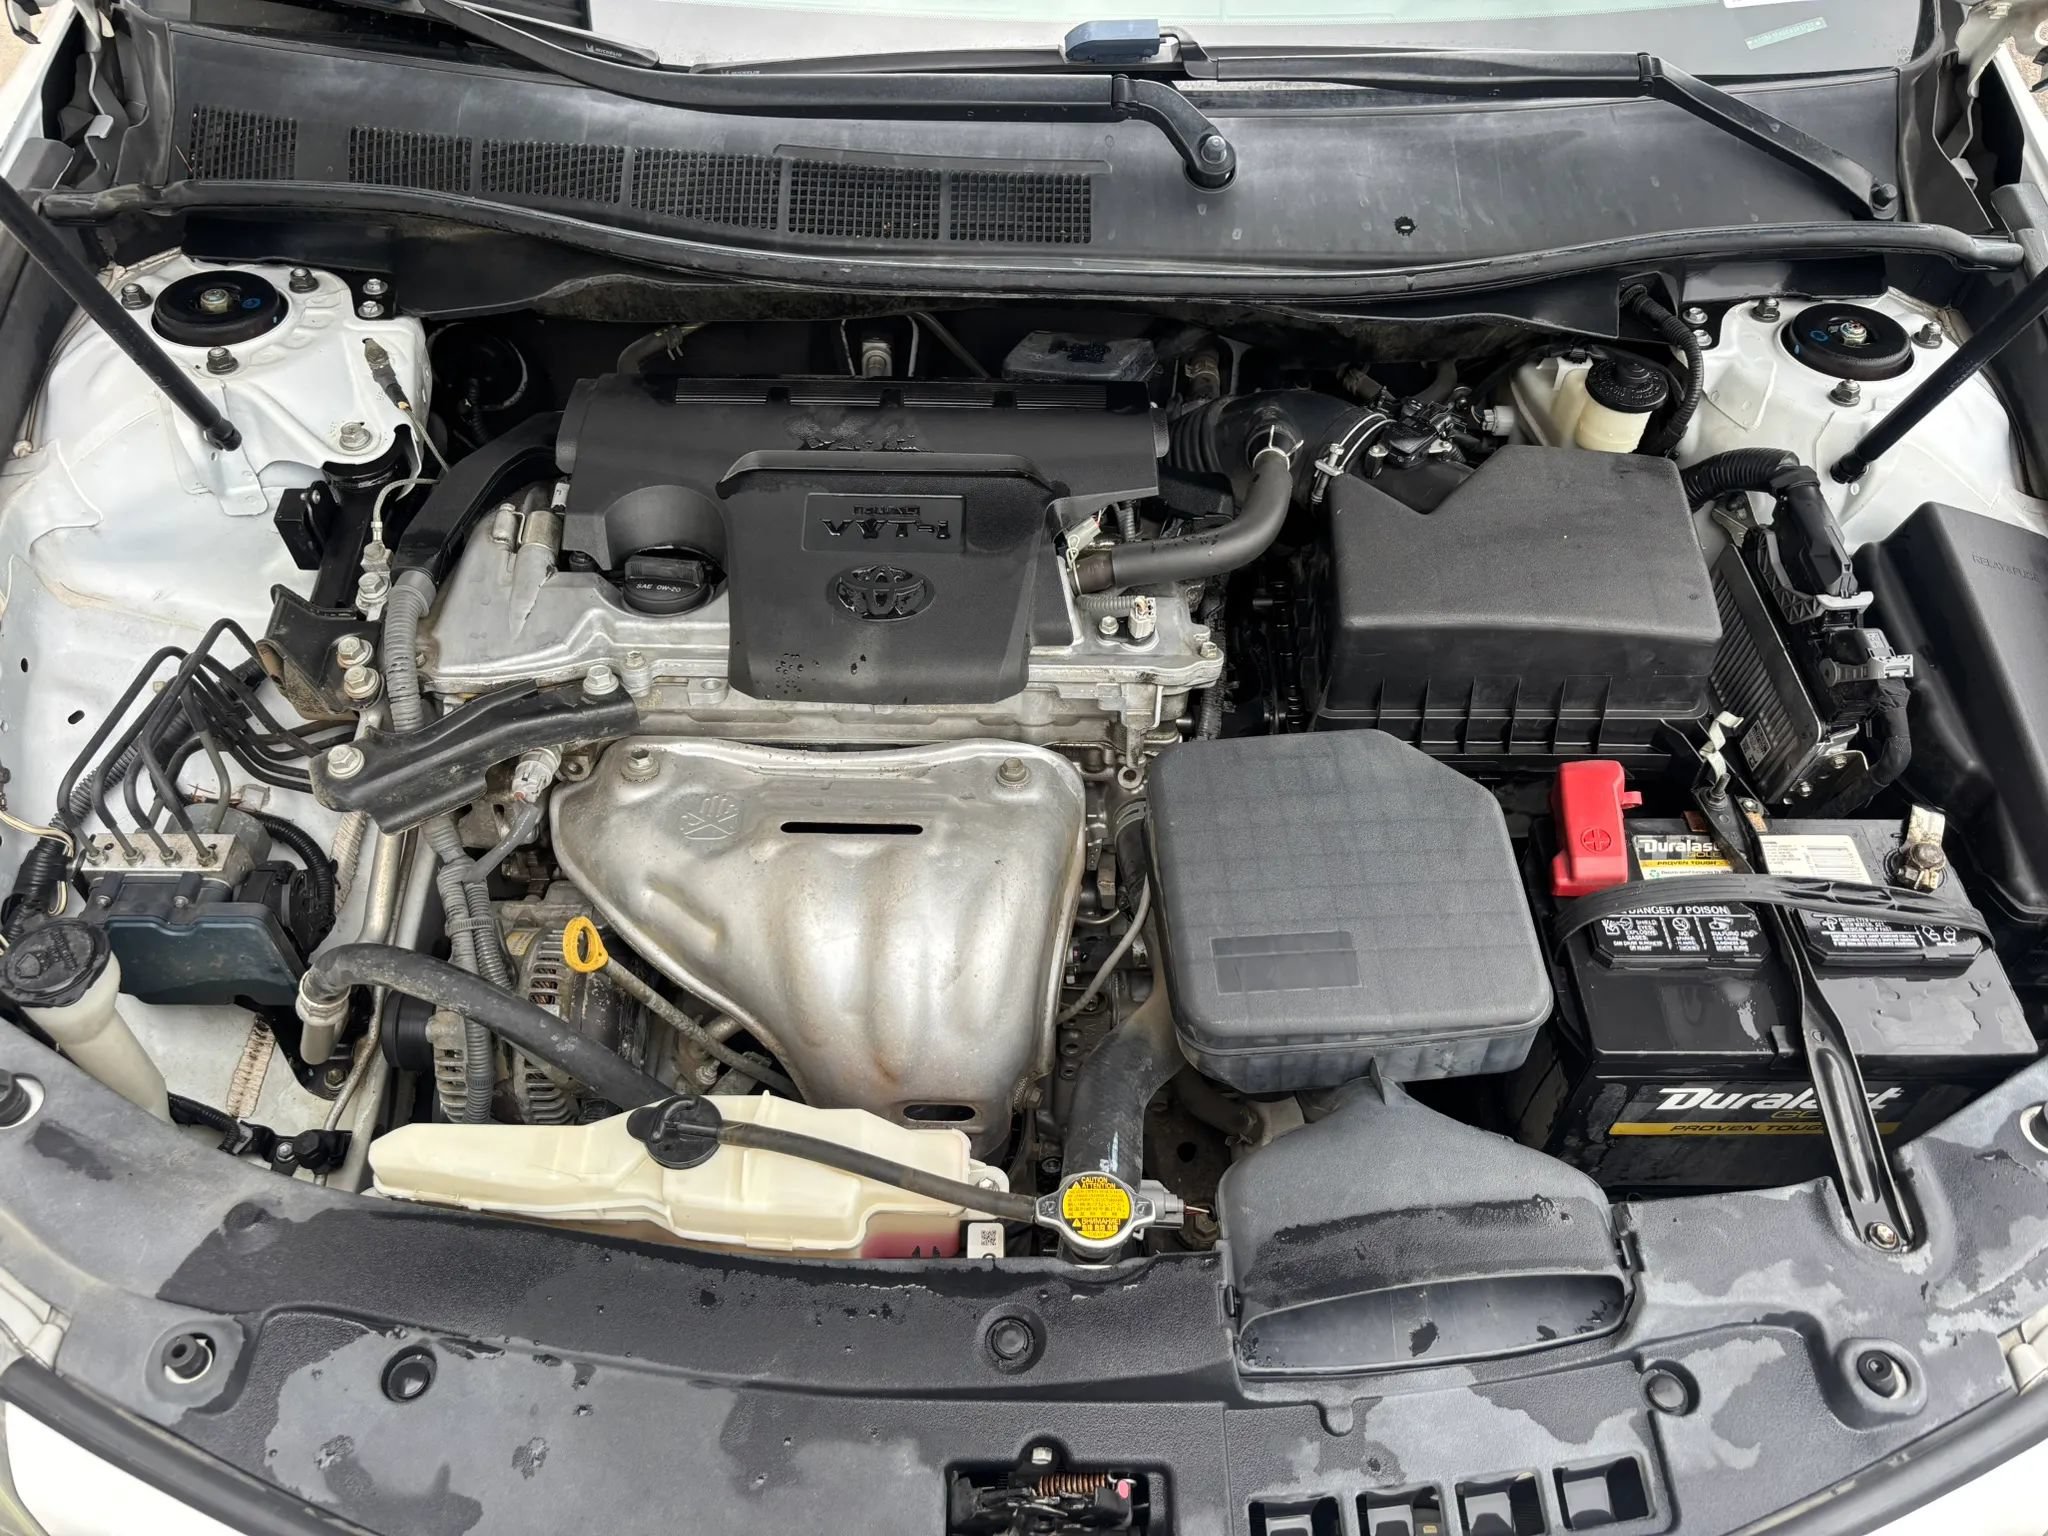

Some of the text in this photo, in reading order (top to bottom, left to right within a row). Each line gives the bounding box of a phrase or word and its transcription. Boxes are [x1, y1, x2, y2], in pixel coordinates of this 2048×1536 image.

[1628, 905, 1675, 915] DANGER
[1685, 905, 1729, 915] POISON
[1656, 1087, 1904, 1110] Duralt
[1766, 1124, 1824, 1132] TOUG
